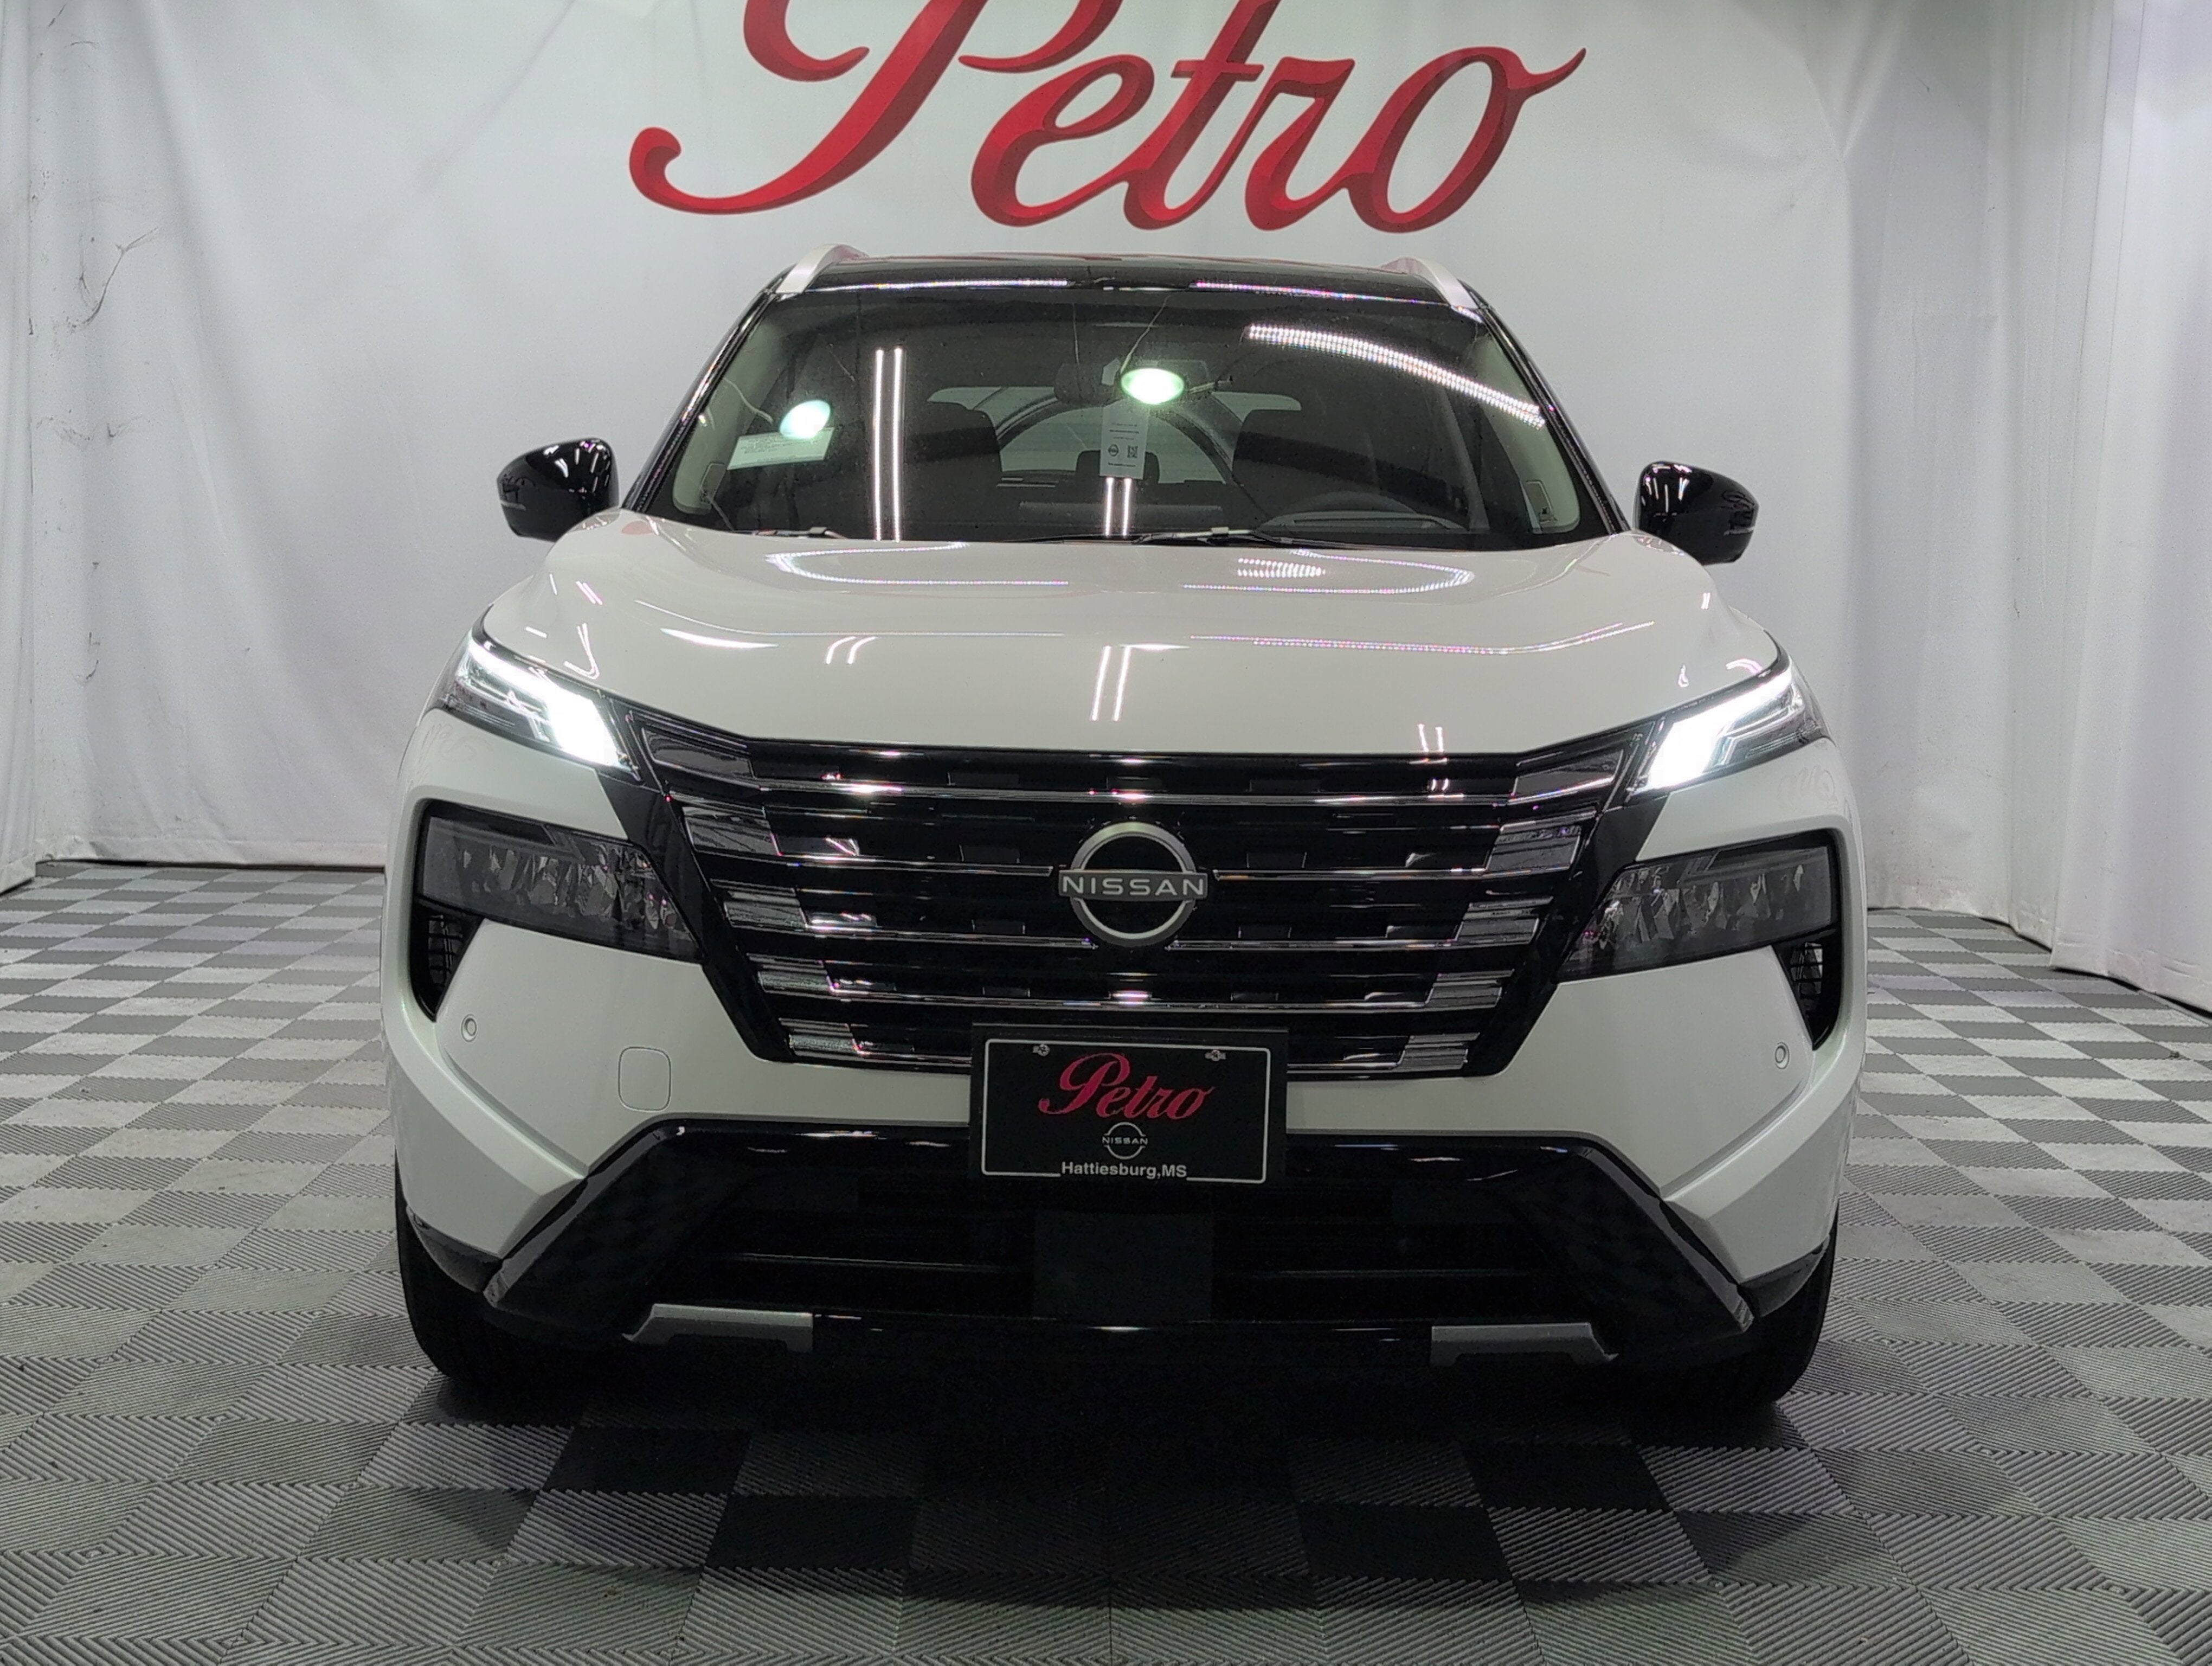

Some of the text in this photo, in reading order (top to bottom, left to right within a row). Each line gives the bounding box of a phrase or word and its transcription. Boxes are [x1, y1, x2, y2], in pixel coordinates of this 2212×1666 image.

[629, 0, 1586, 233] Petro
[1063, 875, 1204, 895] NISSAN
[1038, 1053, 1216, 1119] Petro
[1102, 1136, 1148, 1145] NISSAN
